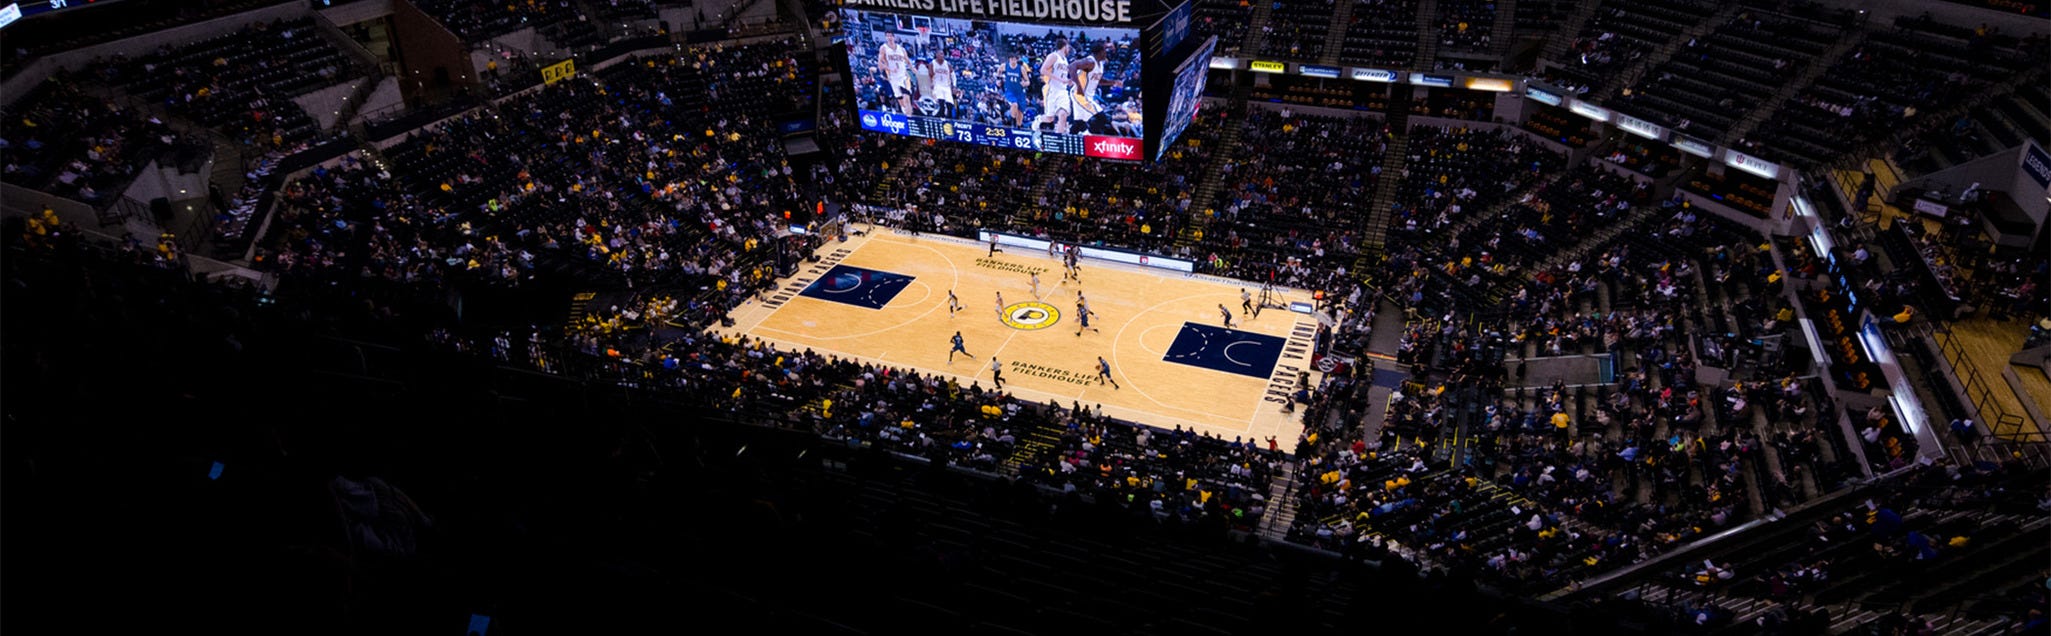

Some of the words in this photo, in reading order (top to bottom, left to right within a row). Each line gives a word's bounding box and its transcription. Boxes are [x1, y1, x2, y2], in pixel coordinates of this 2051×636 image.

[988, 0, 1132, 22] FIELDHOUSE
[880, 113, 905, 134] Kroger
[986, 127, 1006, 137] 2:33
[956, 130, 972, 142] 73
[1014, 137, 1031, 149] 62
[1094, 140, 1134, 156] xfinity
[975, 258, 1024, 269] BANKERS
[1282, 321, 1316, 360] INDIANA
[1011, 360, 1071, 377] BANKERS
[1012, 366, 1092, 387] FIELDHOUSE
[1264, 363, 1300, 404] PACERS
